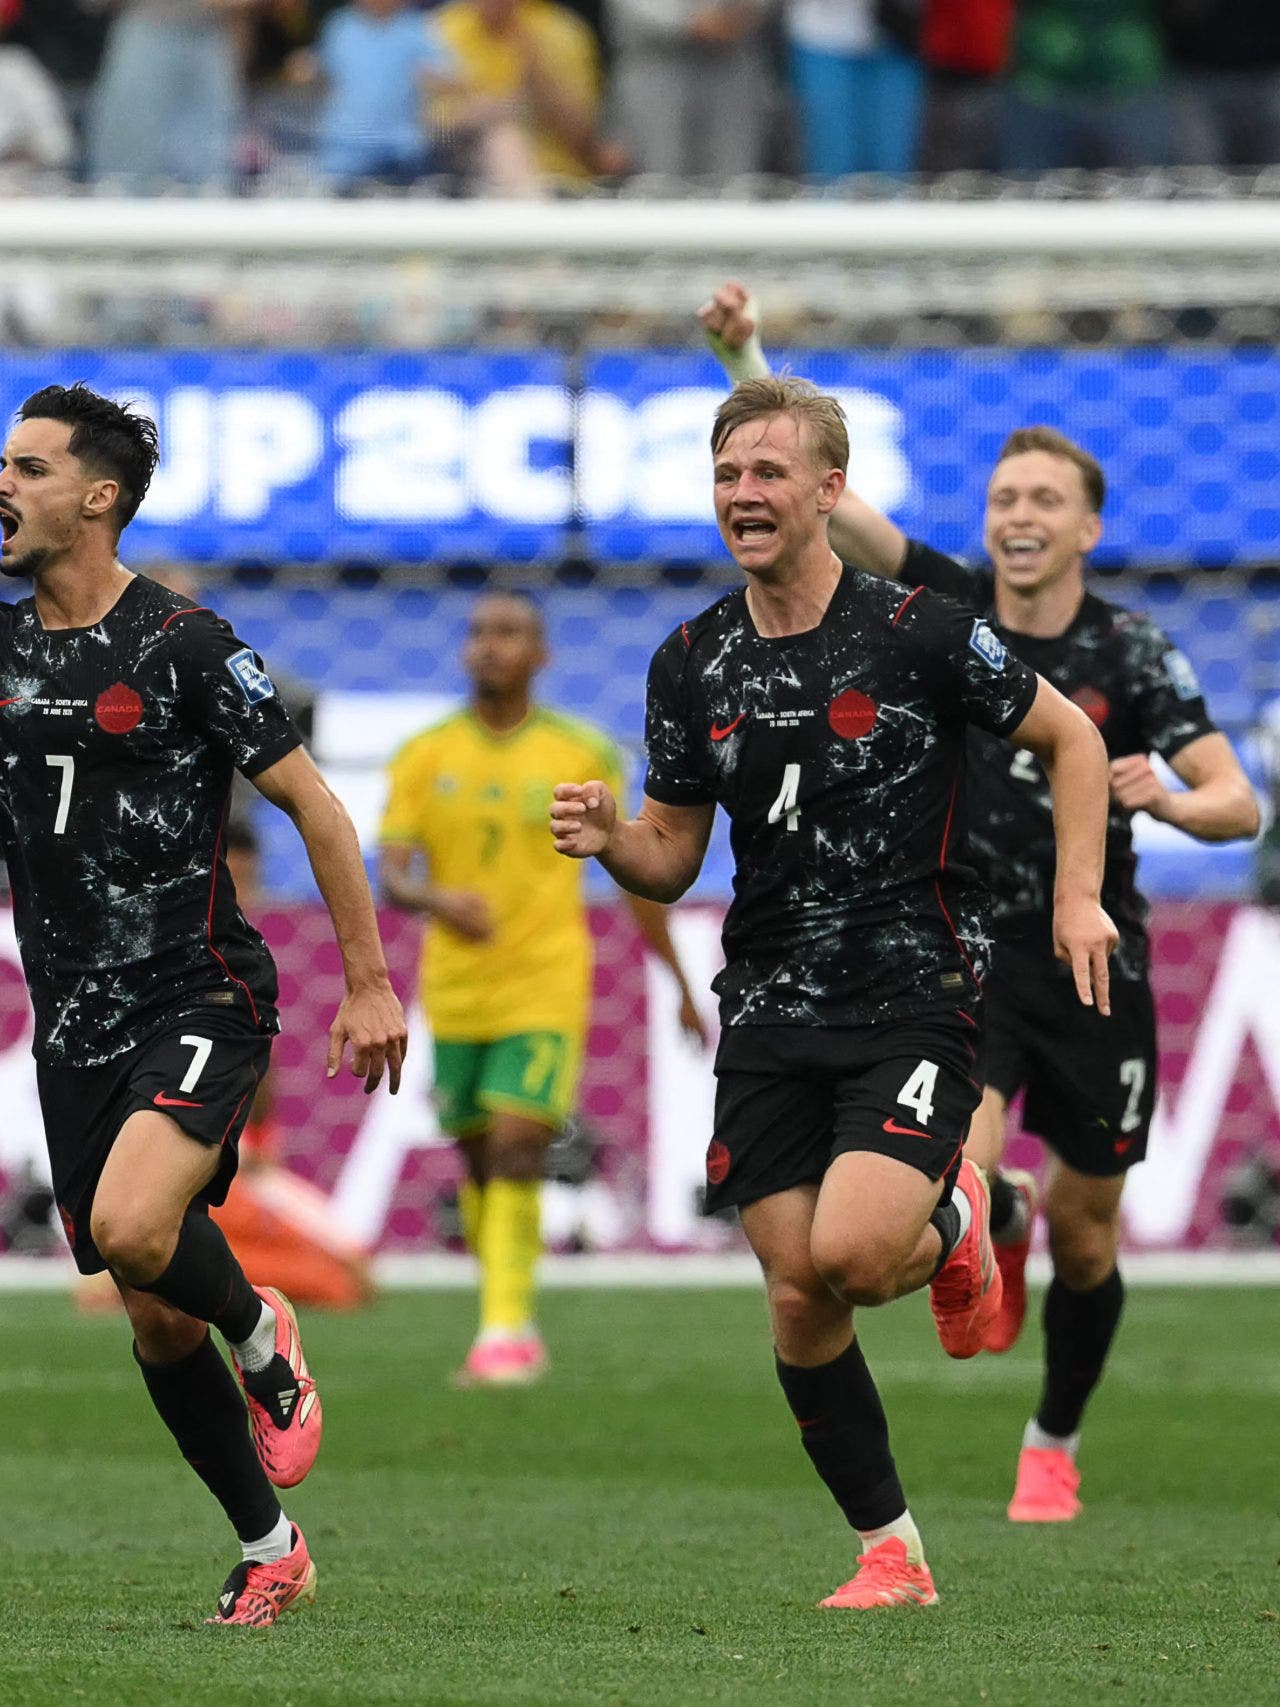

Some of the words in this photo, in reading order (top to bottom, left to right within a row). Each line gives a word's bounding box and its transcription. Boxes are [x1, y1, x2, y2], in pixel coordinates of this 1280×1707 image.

[98, 385, 323, 525] UP
[96, 705, 141, 713] CANADA
[45, 754, 75, 835] 7
[767, 763, 802, 832] 4
[179, 1035, 213, 1094] 7
[896, 1059, 940, 1126] 4
[1120, 1058, 1146, 1133] 2
